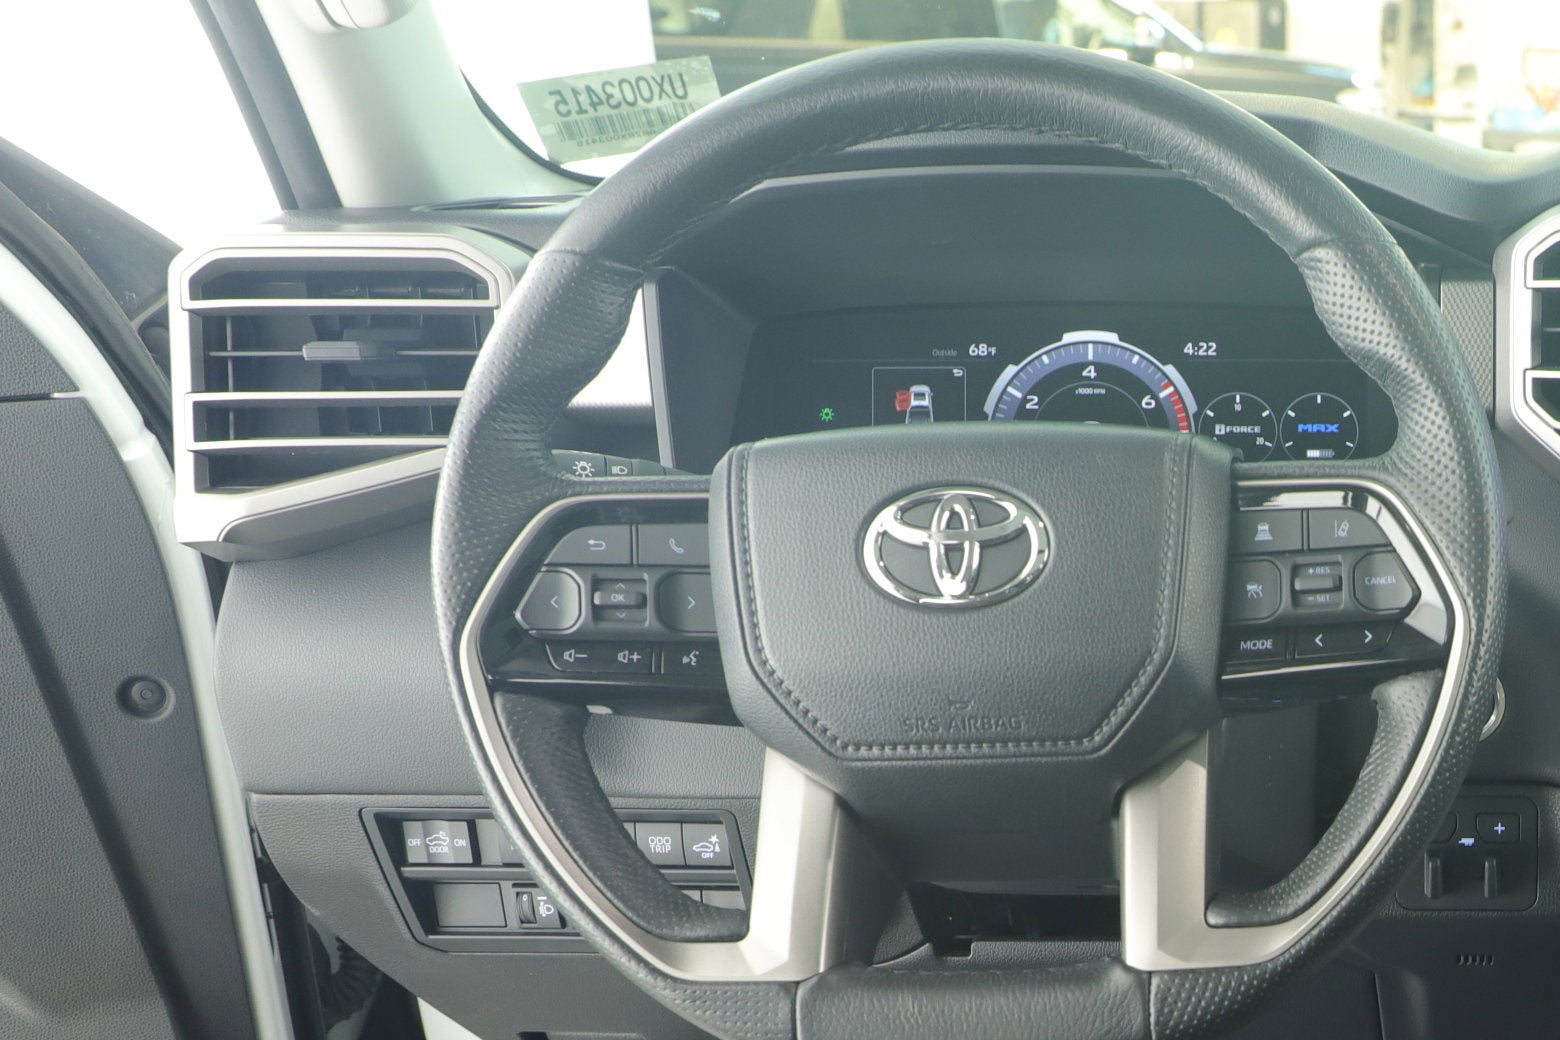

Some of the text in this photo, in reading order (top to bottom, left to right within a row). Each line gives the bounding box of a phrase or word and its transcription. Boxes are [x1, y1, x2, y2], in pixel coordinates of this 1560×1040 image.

[932, 348, 958, 358] Outside
[1183, 341, 1217, 356] 4:22
[1081, 365, 1097, 379] 4
[1025, 395, 1040, 410] 2
[1141, 394, 1156, 410] 6
[1297, 423, 1340, 433] MAX
[1364, 575, 1397, 585] CANCEL
[610, 593, 626, 602] OK
[1239, 638, 1273, 651] MODE
[902, 715, 1025, 735] SRS AIRBAG
[407, 838, 422, 847] OFF
[453, 838, 467, 847] ON
[648, 836, 672, 846] ODO
[429, 846, 449, 854] DOOR
[649, 844, 672, 854] TRIP
